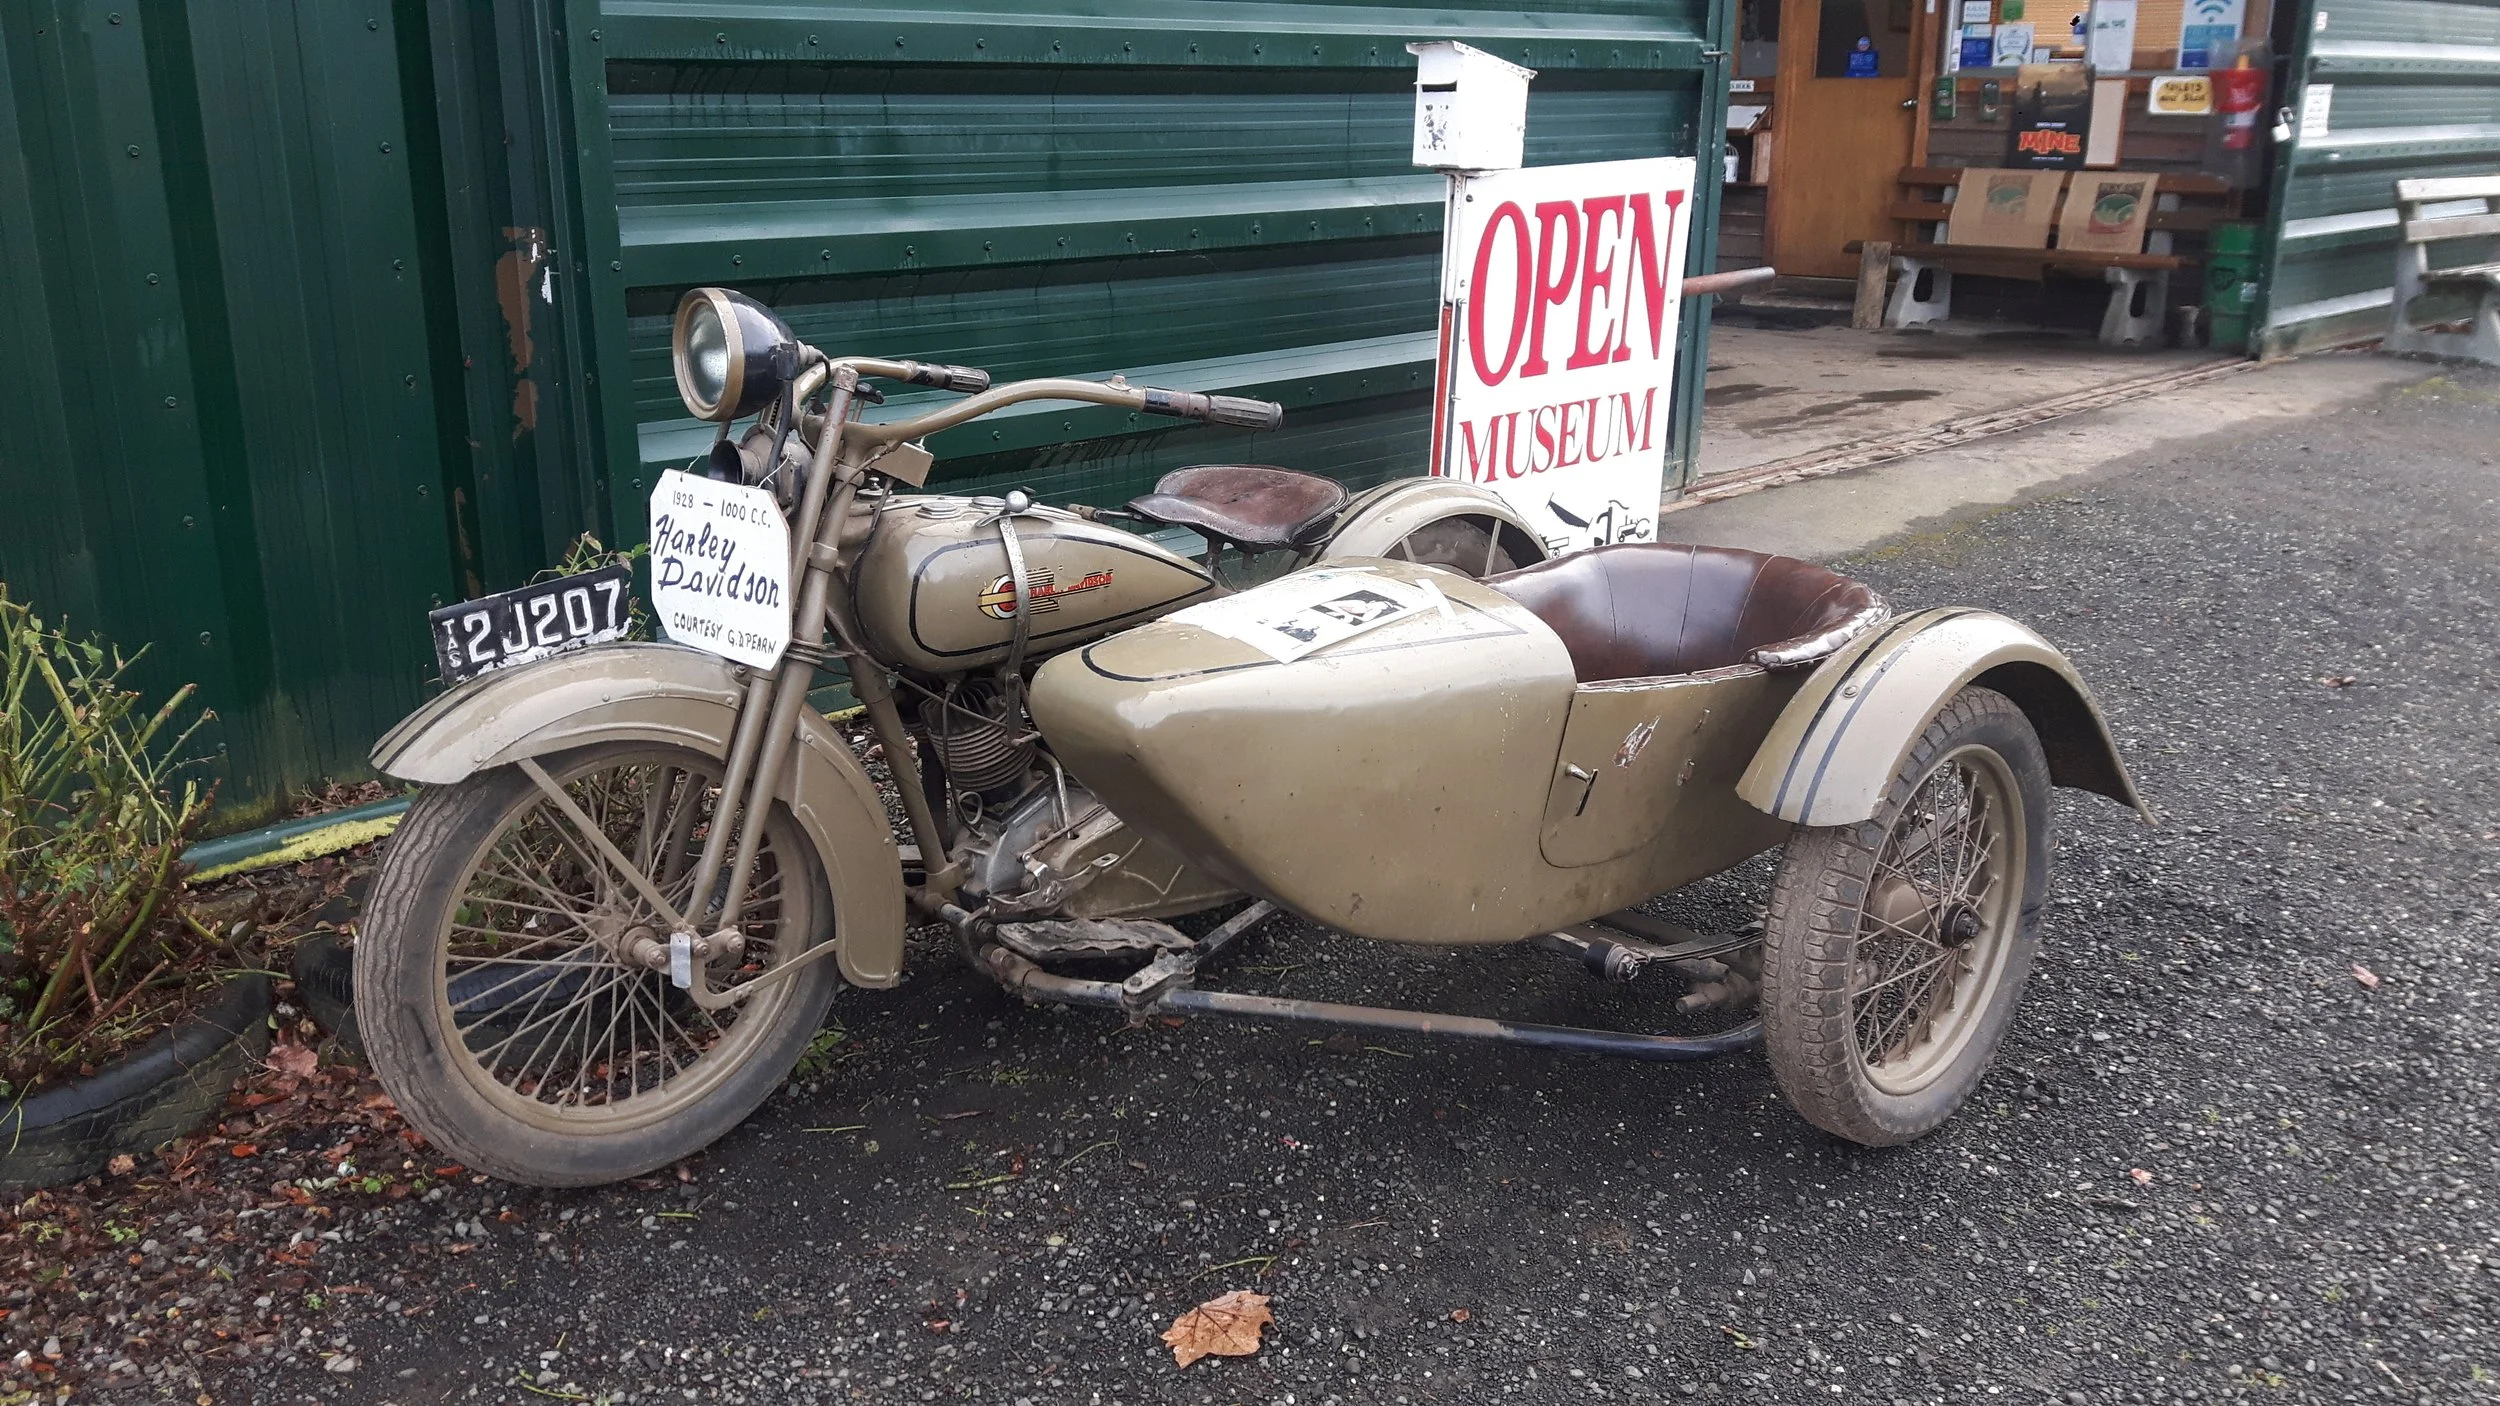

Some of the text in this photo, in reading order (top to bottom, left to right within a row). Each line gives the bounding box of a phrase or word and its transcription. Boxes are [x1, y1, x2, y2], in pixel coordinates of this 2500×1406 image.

[2018, 129, 2081, 154] MINE
[1468, 189, 1685, 387] OPEN
[1459, 386, 1659, 484] MUSEUM
[672, 490, 694, 509] 1928
[720, 499, 746, 521] 1000
[751, 508, 772, 528] C.C.
[657, 555, 780, 609] Davidson
[441, 618, 462, 668] TAS
[463, 578, 621, 663] 2J207
[673, 612, 722, 641] COURTESY
